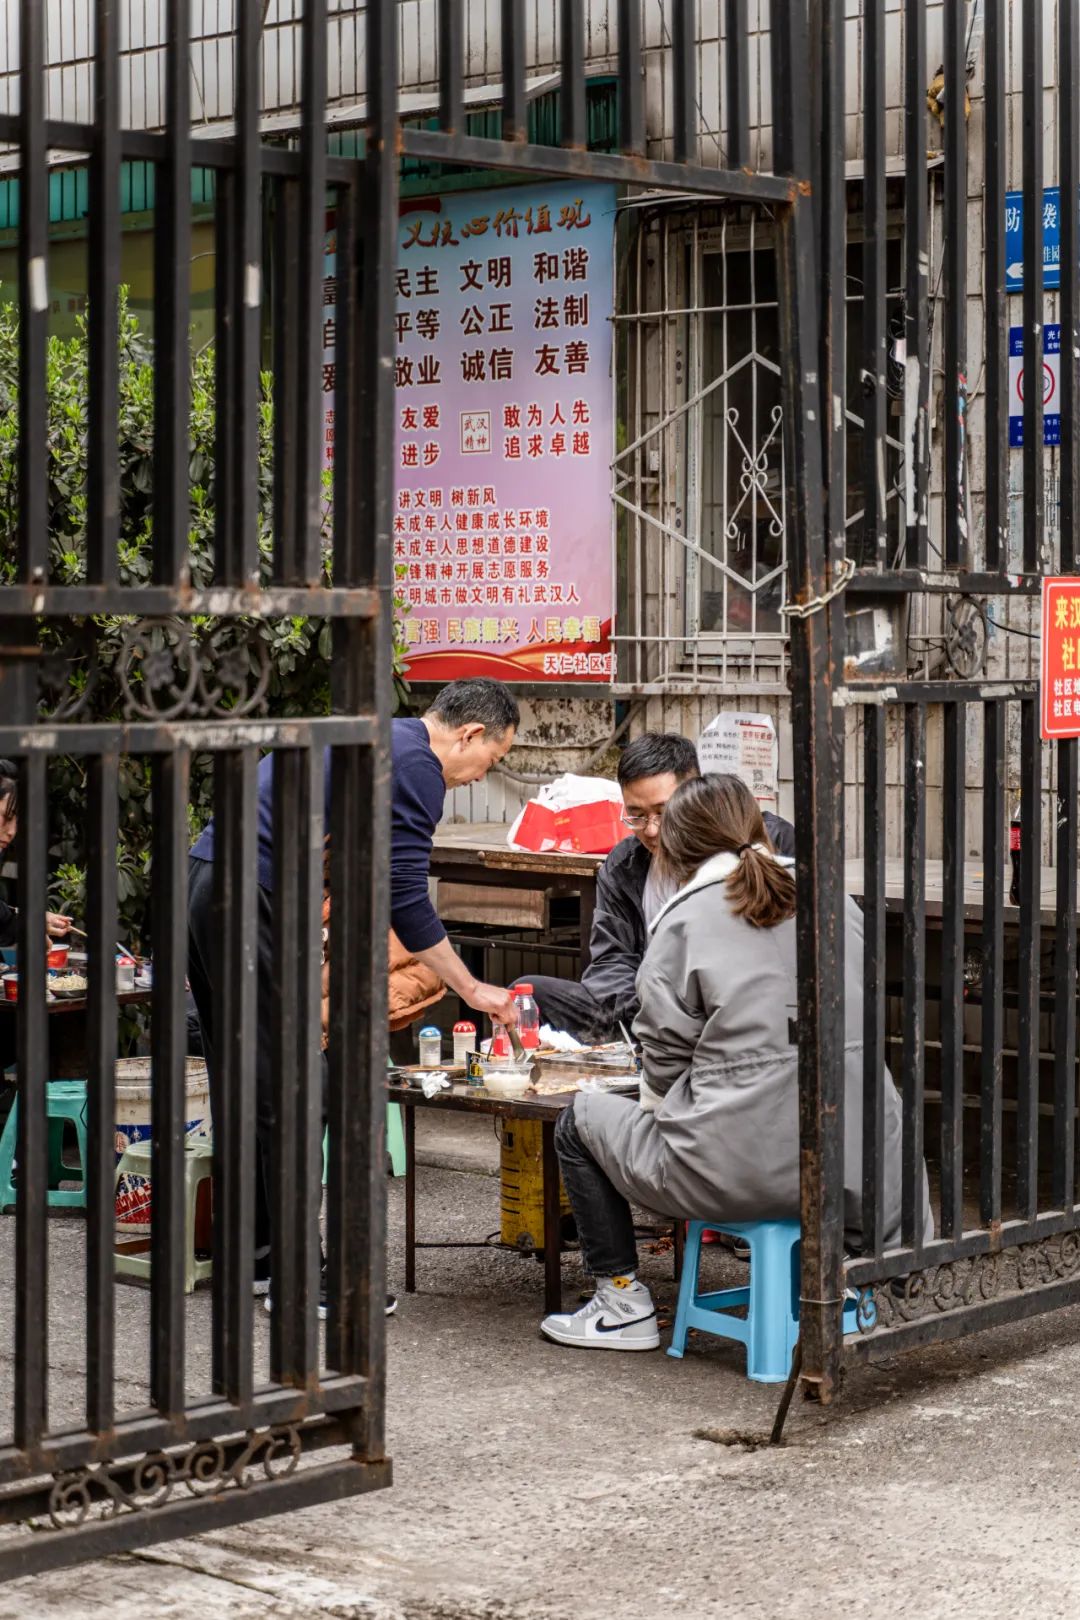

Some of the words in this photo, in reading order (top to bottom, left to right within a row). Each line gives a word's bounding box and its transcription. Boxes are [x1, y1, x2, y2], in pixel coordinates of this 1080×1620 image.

[395, 266, 439, 298] 民主
[459, 257, 512, 292] 文明
[534, 247, 589, 285] 和谐
[395, 308, 440, 343] 平等
[460, 303, 513, 336] 公正
[534, 293, 589, 330] 法制
[395, 355, 441, 388] 敬业
[461, 347, 514, 383] 诚信
[535, 341, 590, 377] 友善
[402, 404, 440, 430] 友爱
[464, 416, 488, 432] 武汉
[504, 399, 590, 429] 敢为人先
[401, 443, 440, 468] 进步
[464, 435, 488, 450] 精神
[504, 431, 590, 460] 追求卓越
[399, 490, 442, 508] 讲文明
[451, 488, 496, 506] 树新风
[394, 510, 549, 532] 未成年人健康成长环境
[394, 535, 549, 557] 未成年人思想道德建设
[398, 619, 440, 643] 富强
[447, 618, 519, 644] 民族振兴
[526, 616, 601, 643] 人民幸福
[1062, 637, 1080, 671] 社
